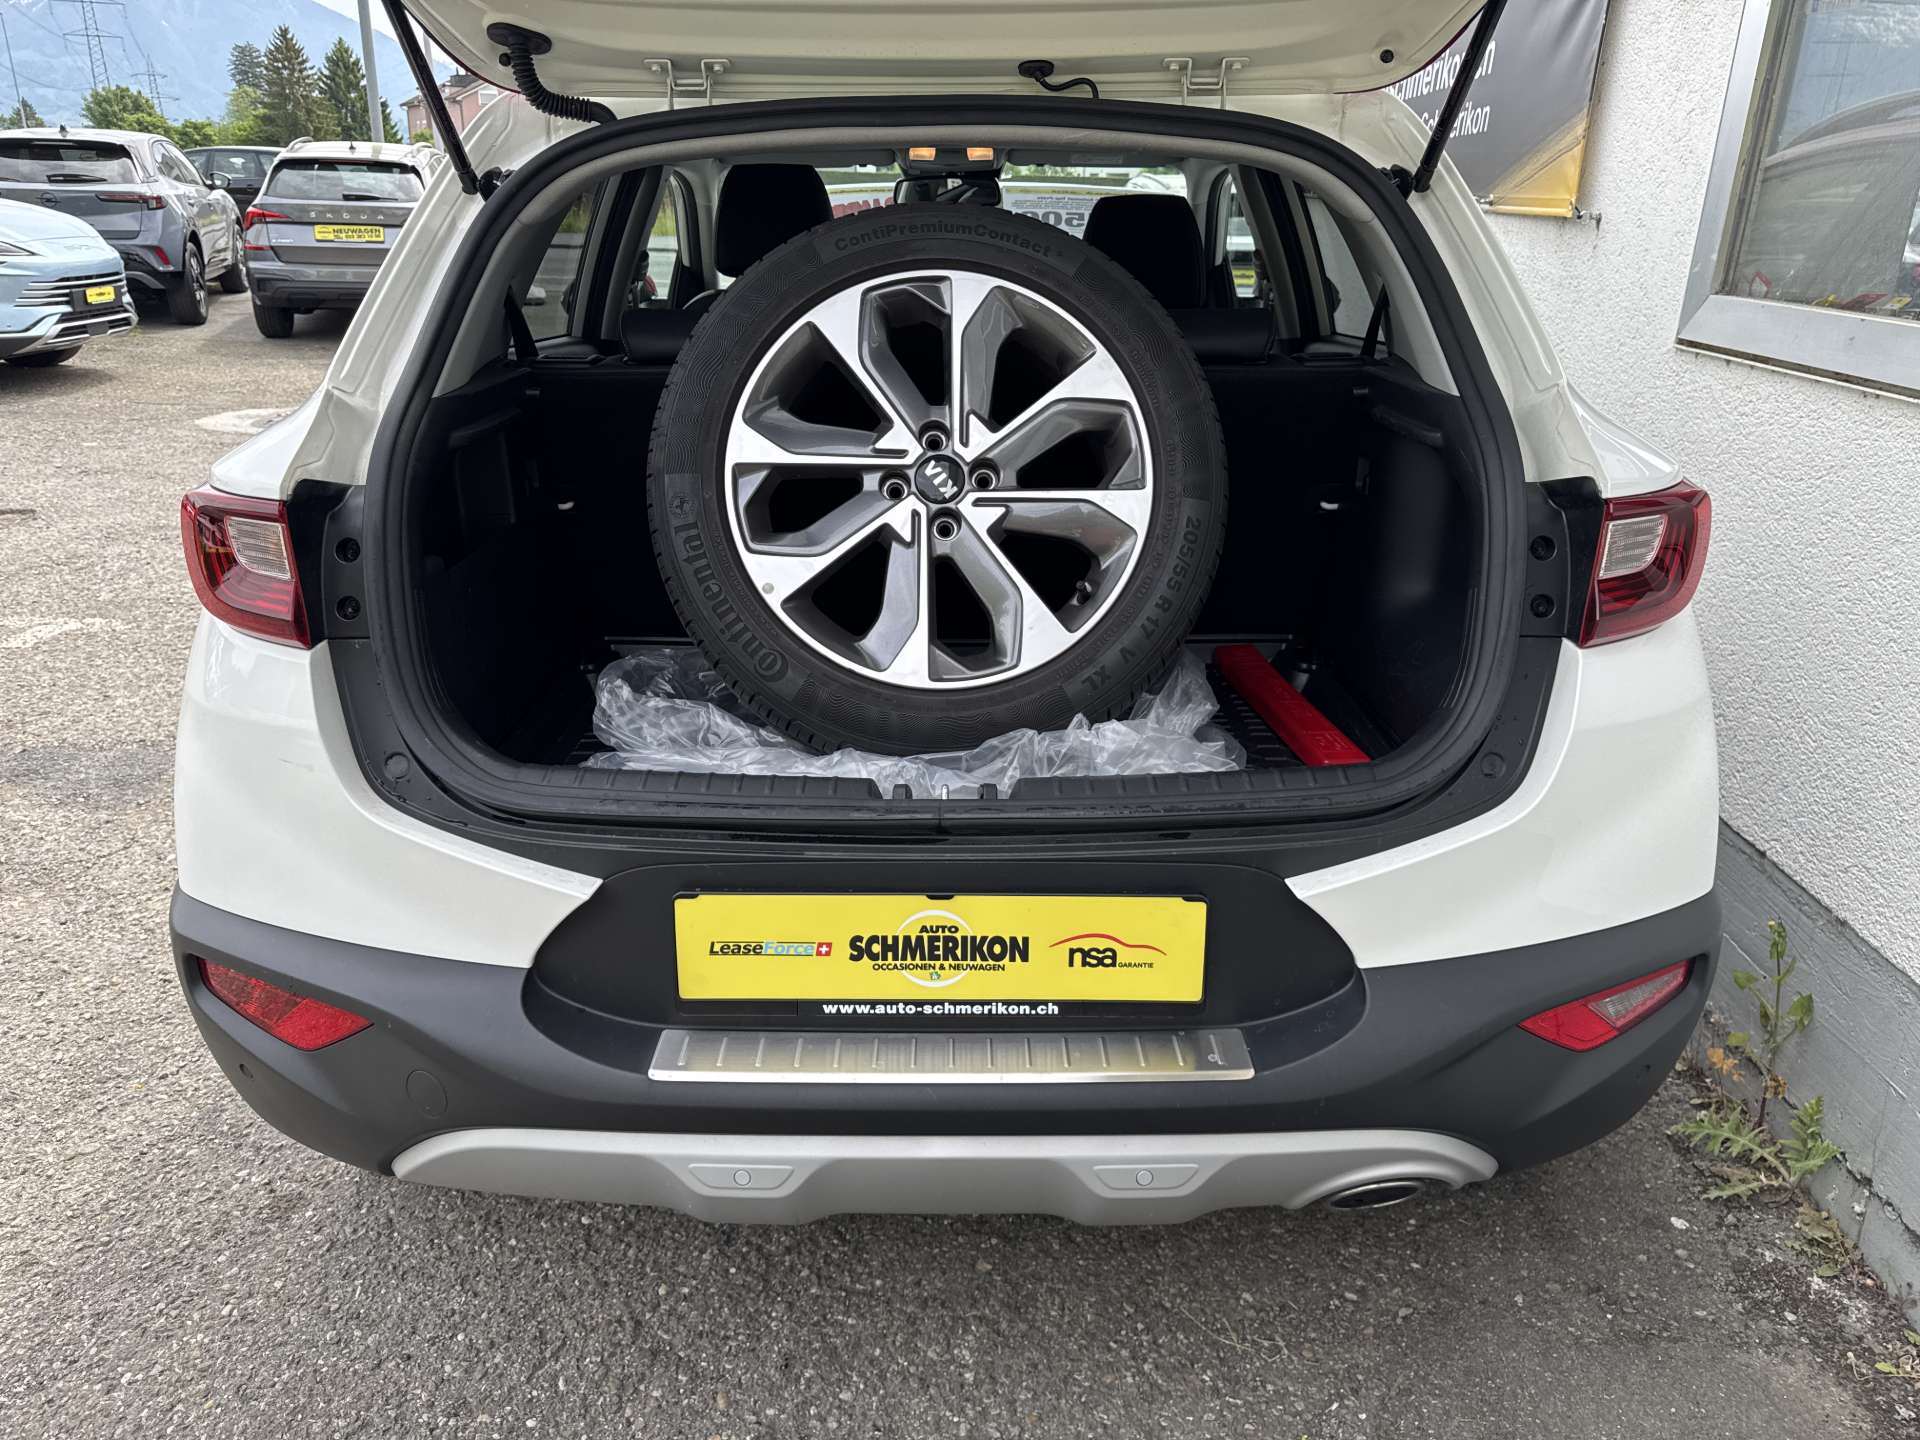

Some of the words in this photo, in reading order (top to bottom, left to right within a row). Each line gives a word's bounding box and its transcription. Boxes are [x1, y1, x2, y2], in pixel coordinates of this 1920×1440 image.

[835, 220, 1051, 259] ContiPremiumContact
[924, 460, 958, 499] KIA
[1166, 515, 1200, 593] 205/55
[674, 520, 789, 683] Continental
[1119, 647, 1137, 664] V
[1081, 665, 1112, 692] XL
[919, 924, 959, 934] AUTO
[709, 941, 815, 956] LeaseForce
[849, 934, 1030, 963] SCHMERIKON
[1068, 947, 1117, 968] nsa
[872, 963, 936, 971] OCCASIONEN
[938, 963, 946, 971] &
[949, 963, 1005, 971] NEUWAGEN
[823, 1002, 1059, 1015] www.auto-schmerikon.ch
